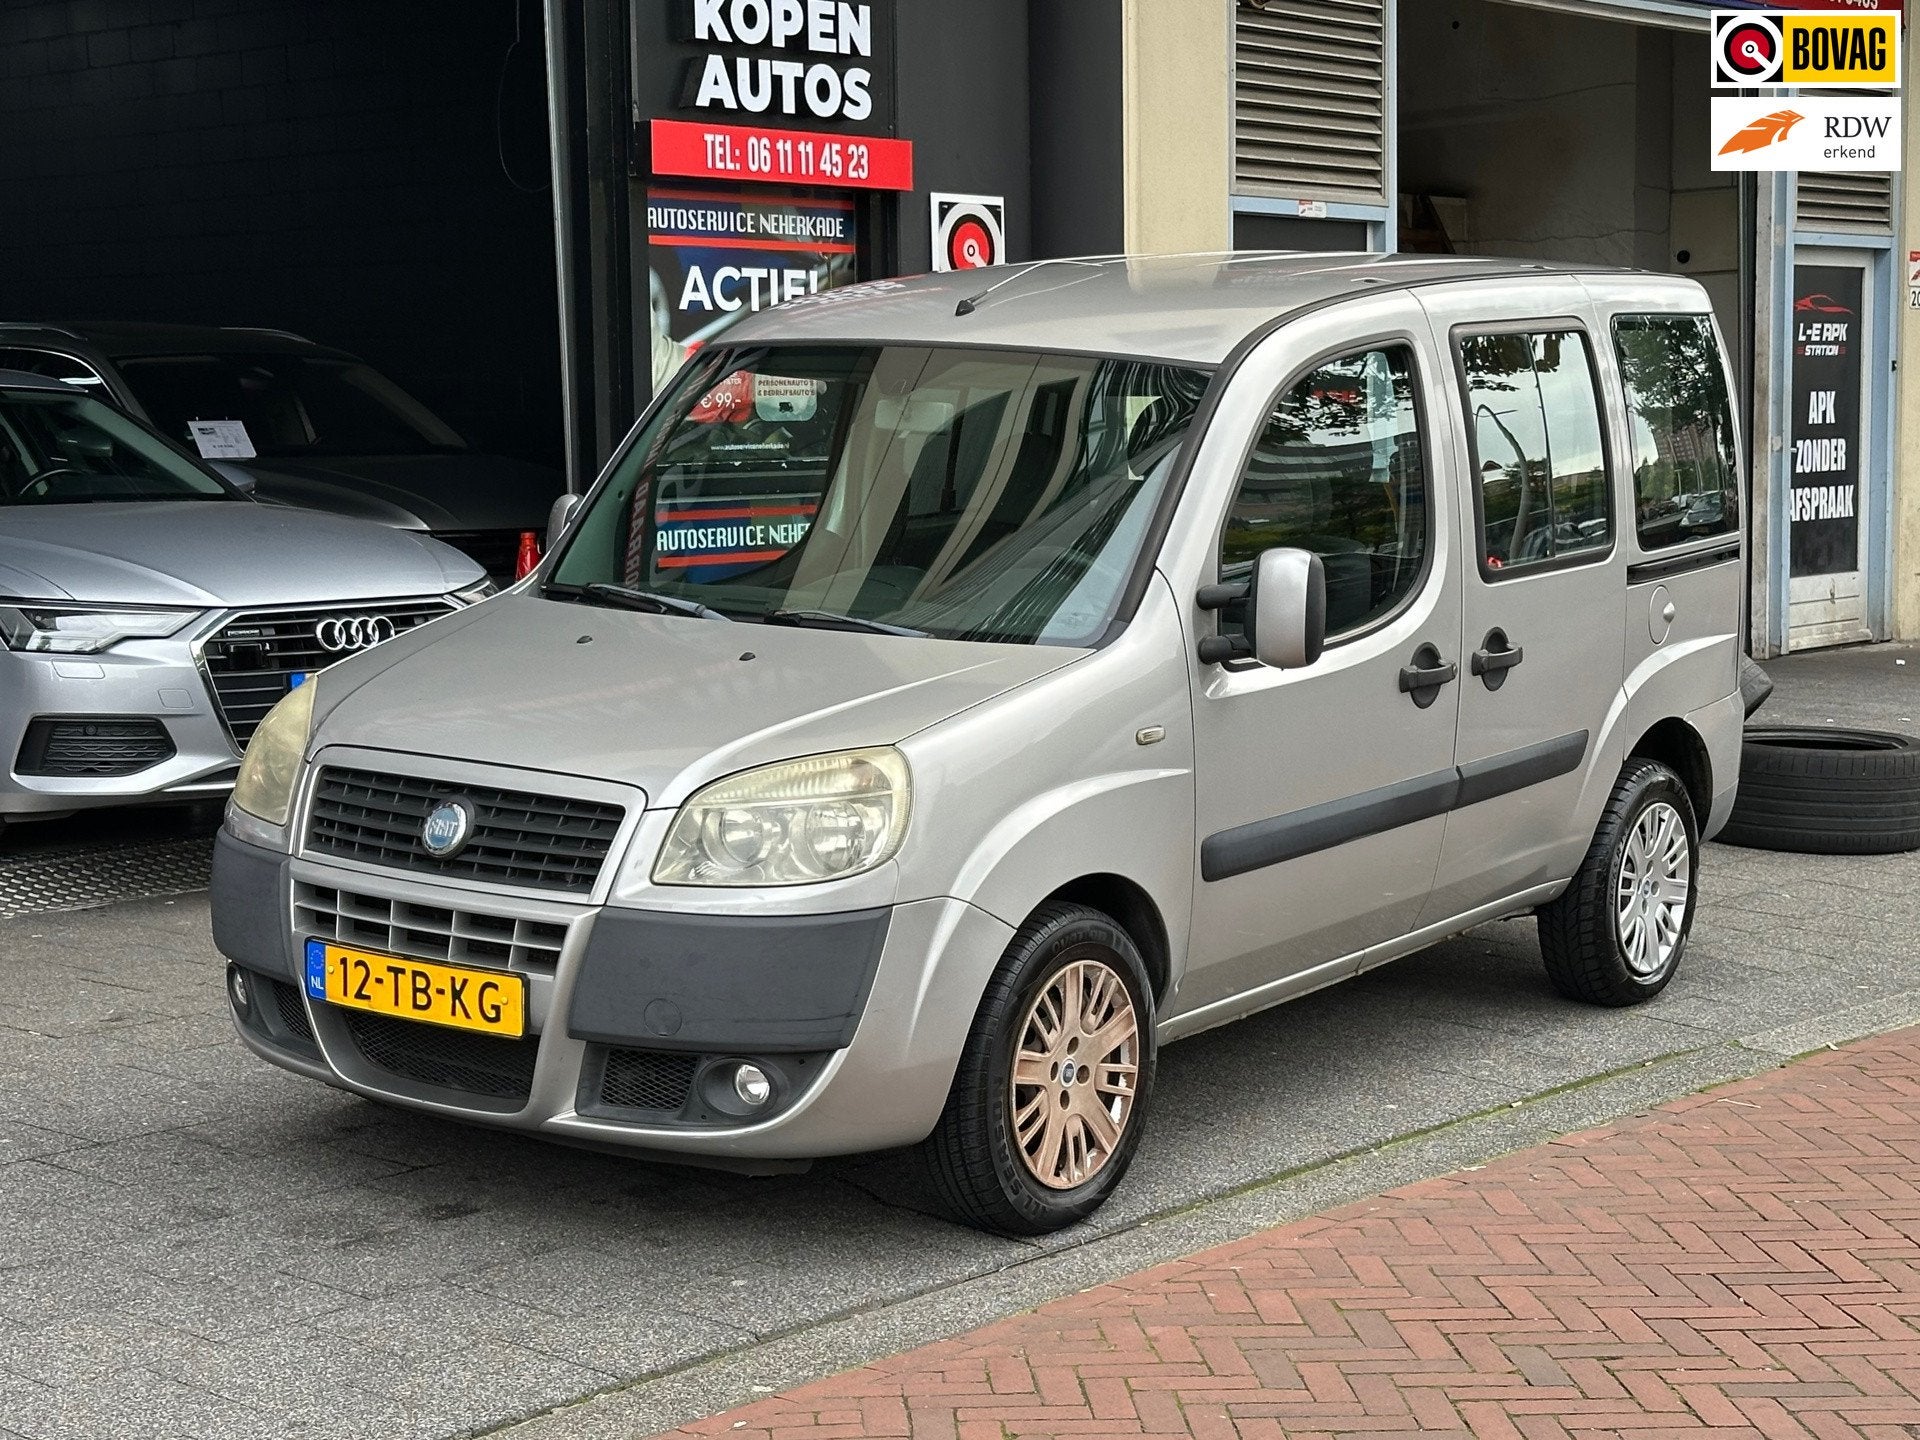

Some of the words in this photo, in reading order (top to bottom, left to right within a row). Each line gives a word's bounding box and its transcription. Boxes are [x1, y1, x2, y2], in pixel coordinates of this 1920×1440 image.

[694, 0, 872, 57] KOPEN
[695, 54, 873, 121] AUTOS
[704, 133, 741, 171] TEL:
[747, 136, 772, 173] 06
[776, 139, 793, 174] 11
[798, 141, 814, 175] 11
[820, 142, 843, 178] 45
[848, 144, 869, 179] 23
[647, 207, 756, 233] AUTOSERVICE
[759, 213, 845, 238] NEHERKADE
[1798, 323, 1822, 342] L-E
[1822, 322, 1848, 342] APK
[1804, 345, 1840, 356] STATION
[715, 392, 742, 410] 99,-
[1808, 391, 1836, 425] APK
[1795, 438, 1847, 474] ZONDER
[1790, 485, 1855, 522] AFSPRAAK
[656, 525, 766, 551] AUTOSERVICE
[311, 976, 325, 991] NL
[339, 956, 502, 1024] 12-TB-KG
